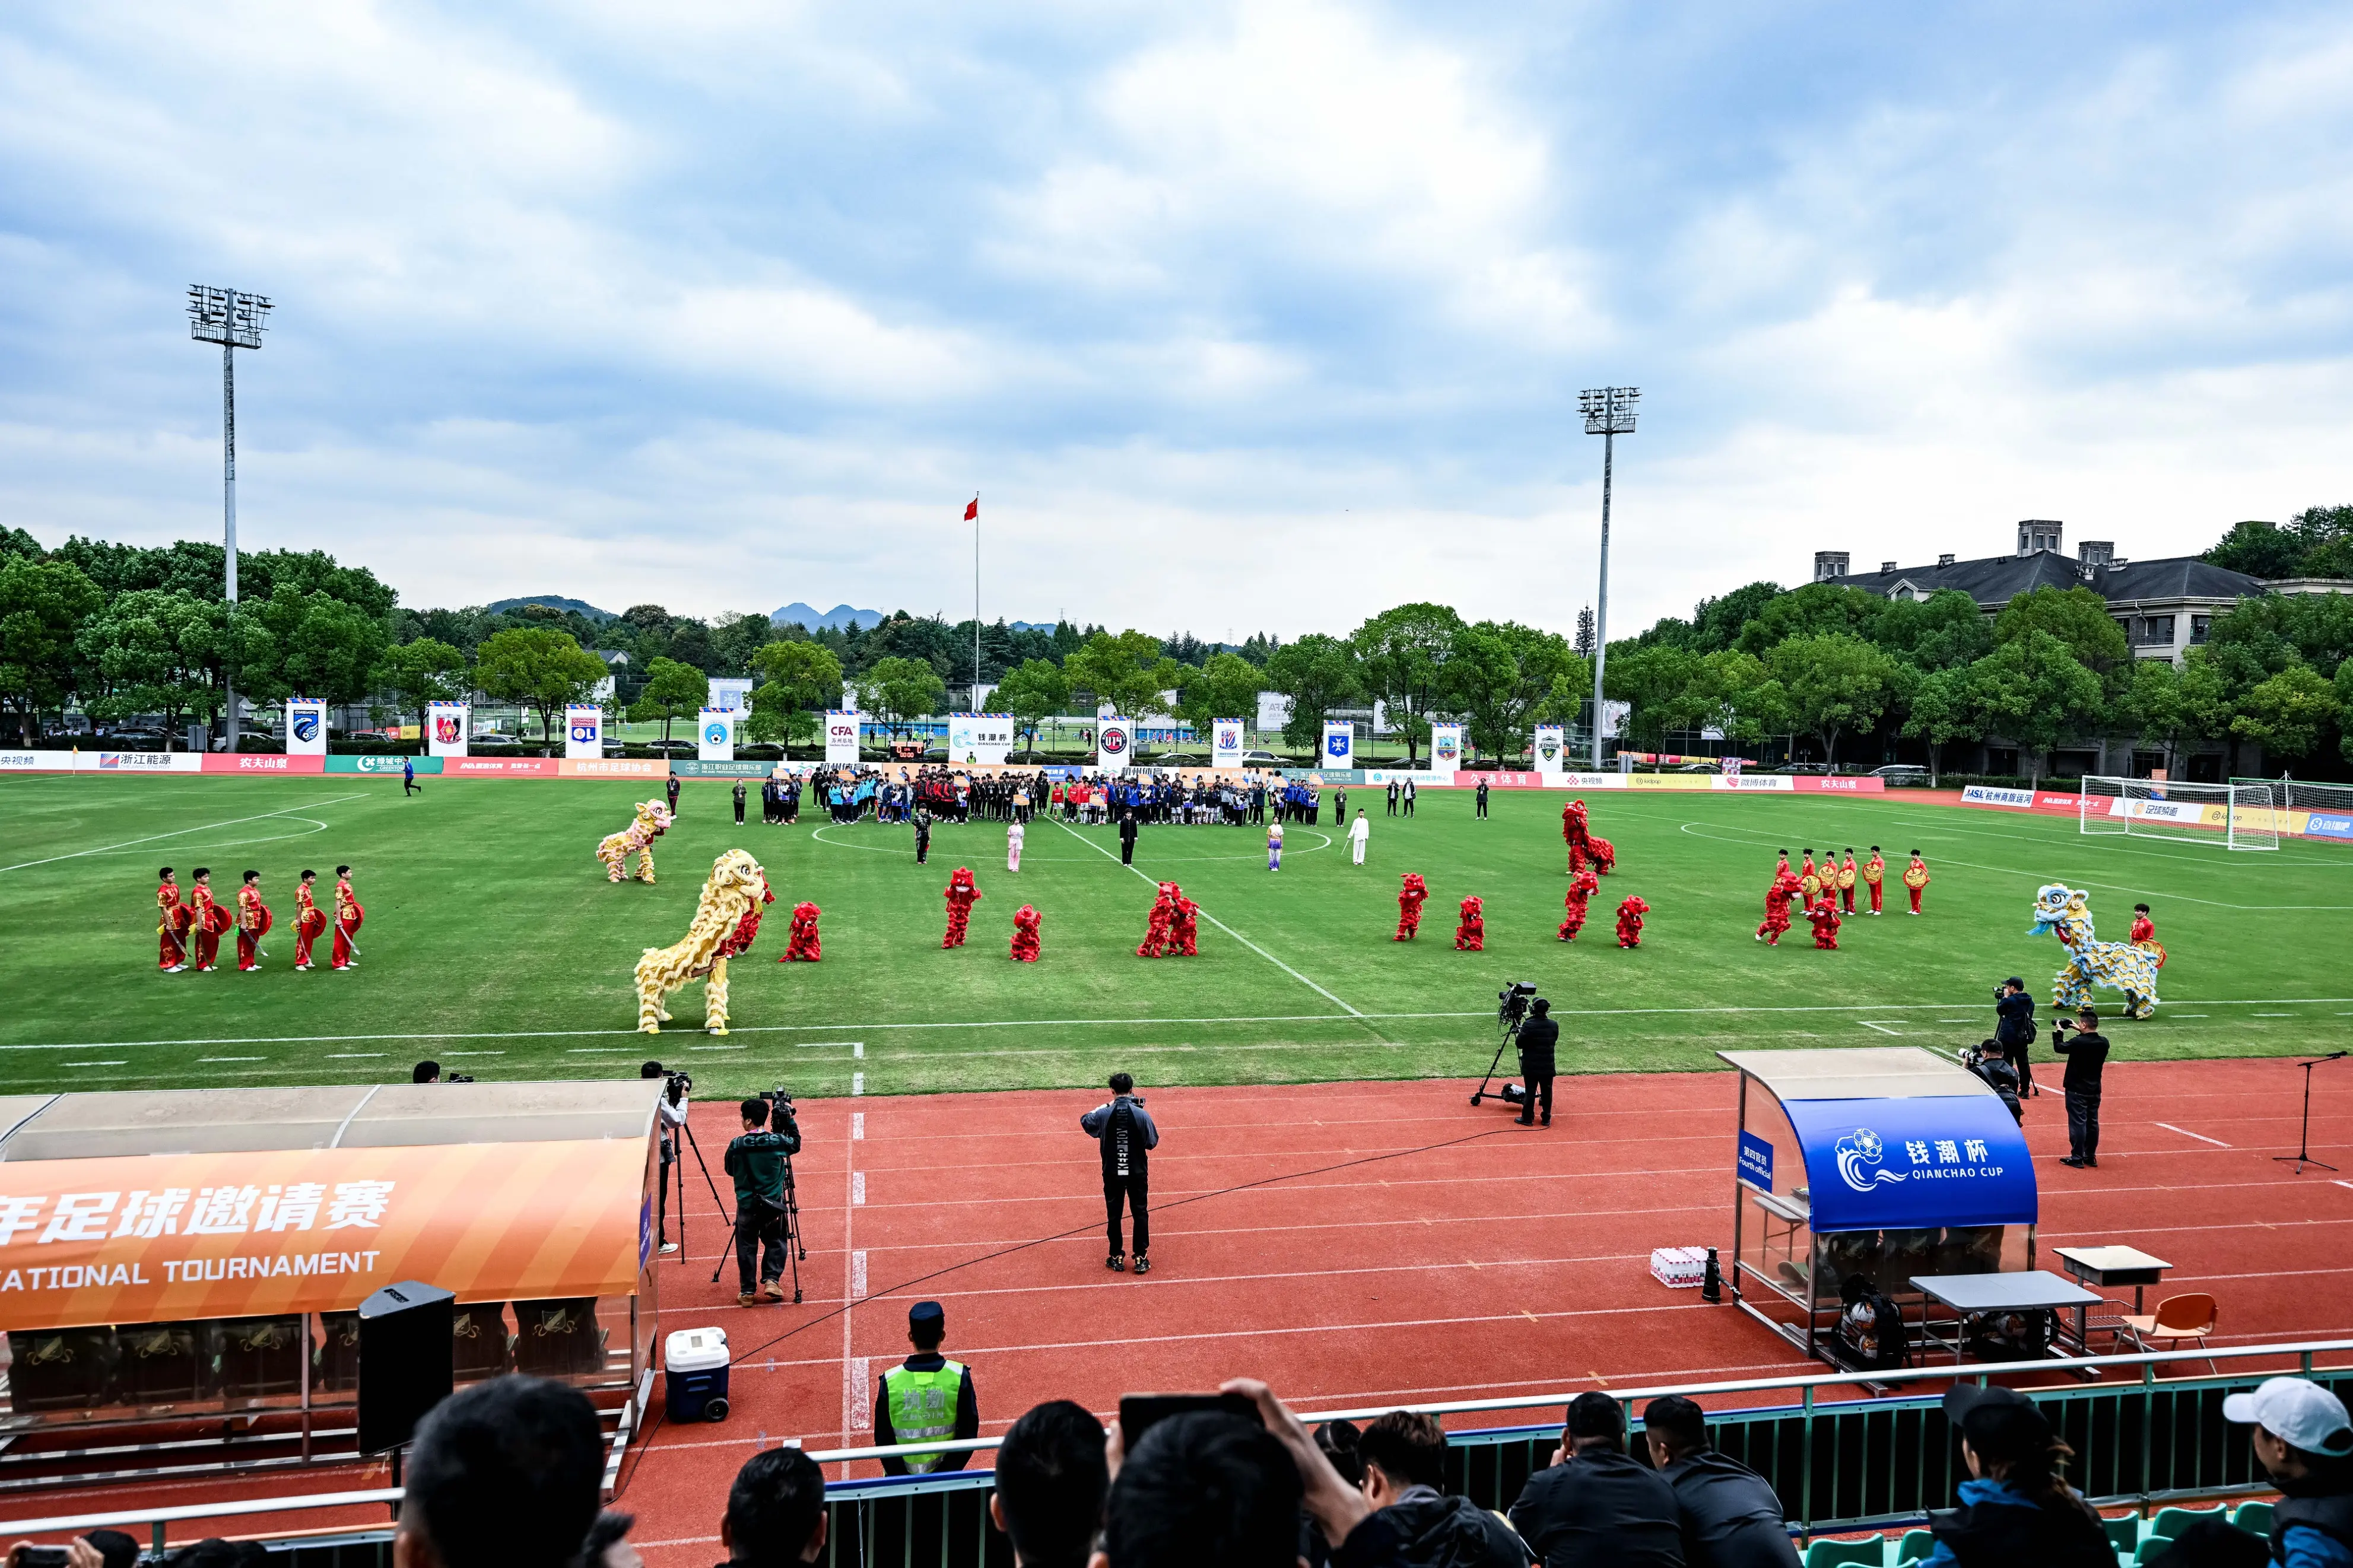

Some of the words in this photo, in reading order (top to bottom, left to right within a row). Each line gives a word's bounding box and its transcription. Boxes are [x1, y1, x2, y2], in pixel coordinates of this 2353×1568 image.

[831, 726, 853, 736] CFA
[1106, 736, 1122, 746] U14
[1, 756, 34, 765] 央视频
[120, 754, 172, 765] 浙江能源
[240, 757, 288, 769] 农夫山泉
[377, 757, 411, 765] 绿城中
[577, 762, 652, 772] 杭州市足球协会
[1471, 774, 1527, 784] 久涛体育
[1741, 778, 1777, 787] 微博体育
[1821, 779, 1857, 789] 农夫山泉
[1986, 791, 2033, 804] 杭州商旅运河
[2145, 804, 2179, 816] 足球频道
[2322, 820, 2351, 832] 直播吧
[1744, 1146, 1767, 1166] 第四官员
[1905, 1139, 1989, 1165] 钱潮杯
[1739, 1156, 1755, 1171] Fourth
[1755, 1166, 1771, 1181] official
[1913, 1167, 1976, 1179] QIANCHAO
[1980, 1167, 2003, 1177] CUP
[0, 1264, 149, 1292] ATIONAL
[163, 1251, 380, 1283] TOURNAMENT
[903, 1388, 945, 1411] 执勤
